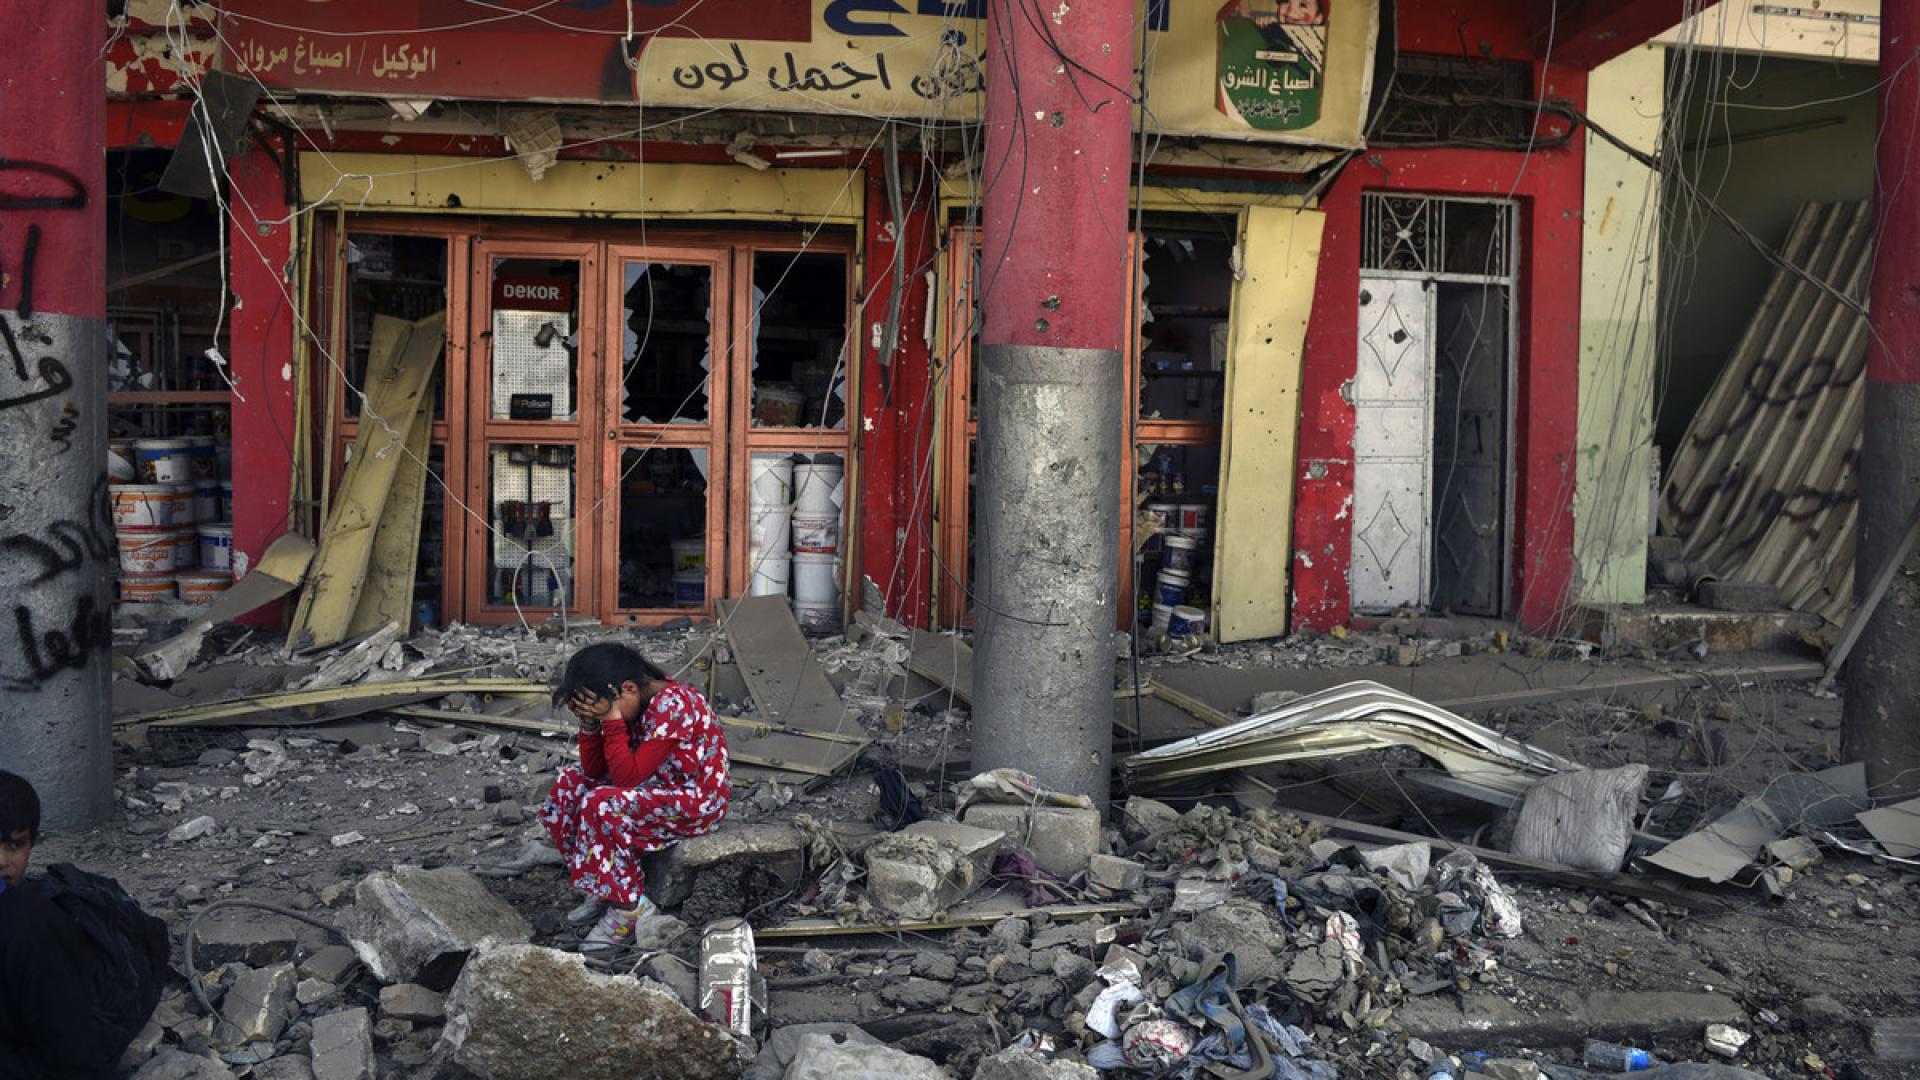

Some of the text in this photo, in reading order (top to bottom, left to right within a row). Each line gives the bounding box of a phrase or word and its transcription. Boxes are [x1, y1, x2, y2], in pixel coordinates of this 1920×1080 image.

[236, 39, 289, 73] مروان
[293, 35, 350, 75] اصباغ
[373, 43, 436, 79] الوكيل
[673, 42, 749, 91] لون
[768, 52, 891, 100] اجمل
[1223, 64, 1315, 95] اصباغ الشرق
